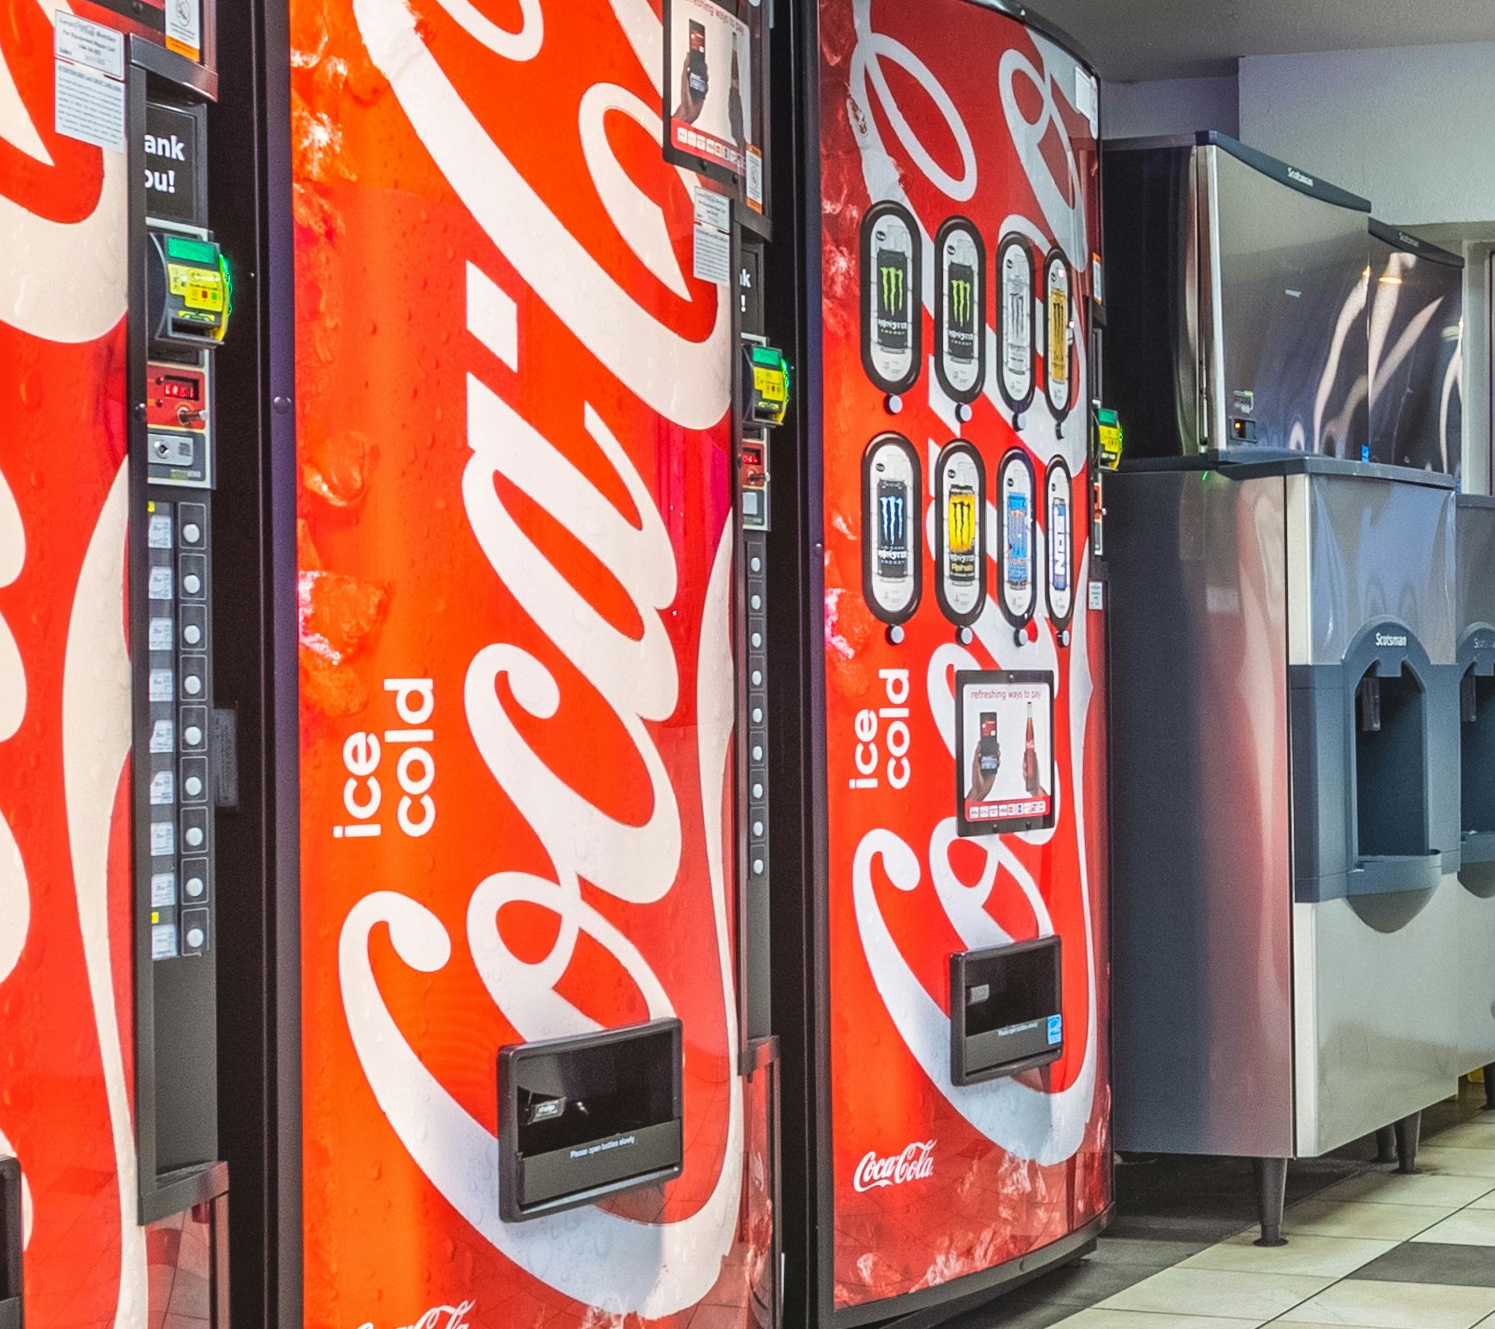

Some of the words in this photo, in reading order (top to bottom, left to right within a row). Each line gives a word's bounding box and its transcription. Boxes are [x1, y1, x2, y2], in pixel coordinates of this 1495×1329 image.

[144, 134, 185, 161] ank
[144, 168, 175, 194] ou!
[1375, 632, 1407, 647] Scotsman
[970, 689, 1006, 701] refreshing
[1008, 690, 1023, 701] ways
[1031, 690, 1042, 701] pay
[849, 708, 879, 789] ice
[879, 669, 910, 790] cold
[334, 731, 382, 838] ice
[388, 679, 436, 838] cold
[853, 1139, 936, 1194] Coca-Cola
